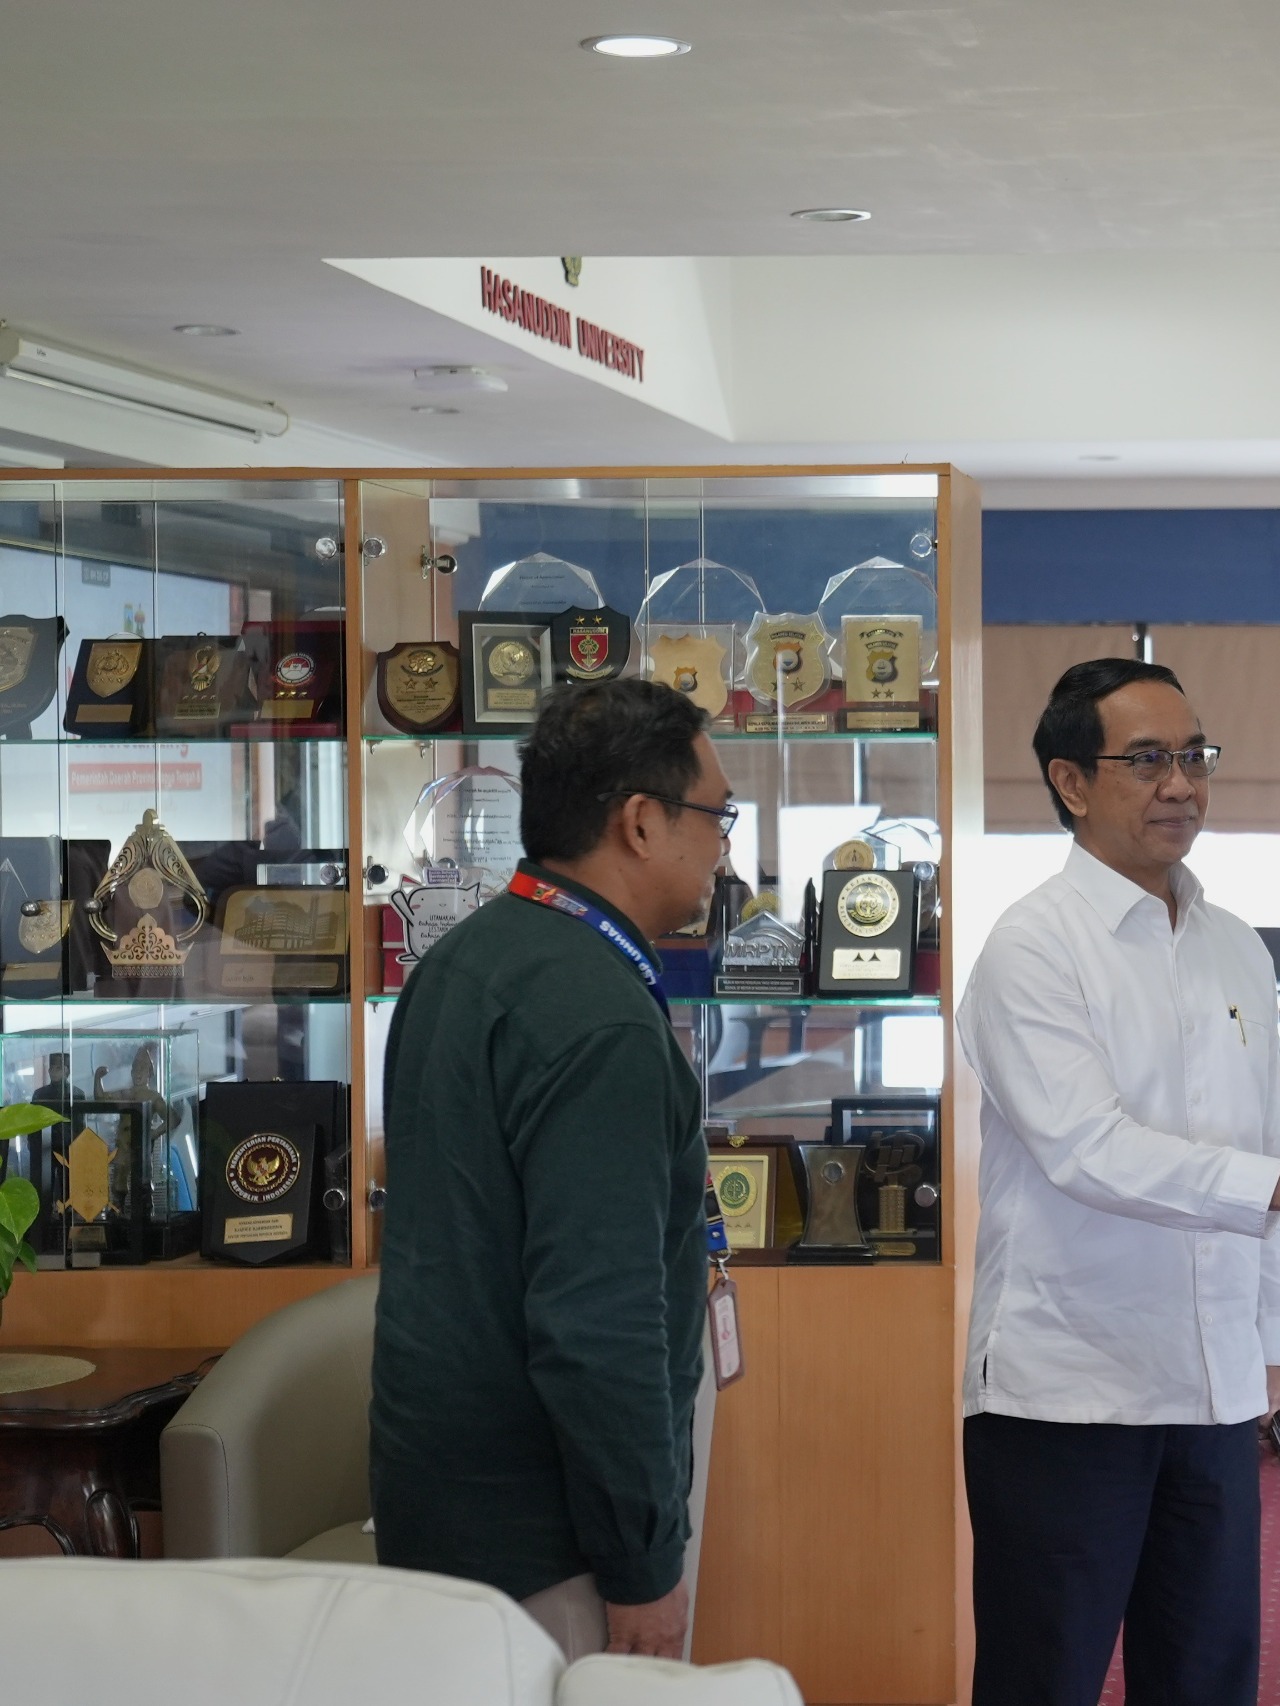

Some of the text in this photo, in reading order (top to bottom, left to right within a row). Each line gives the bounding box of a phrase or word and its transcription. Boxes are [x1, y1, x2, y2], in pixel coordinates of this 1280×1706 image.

[480, 265, 645, 383] HASANUDDIN UNIVERSITY
[599, 920, 642, 961] UNHAS
[230, 1135, 297, 1169] KEMENTERIAN PERTAHANAN
[230, 1174, 296, 1202] REPUBLIK INDONESIA
